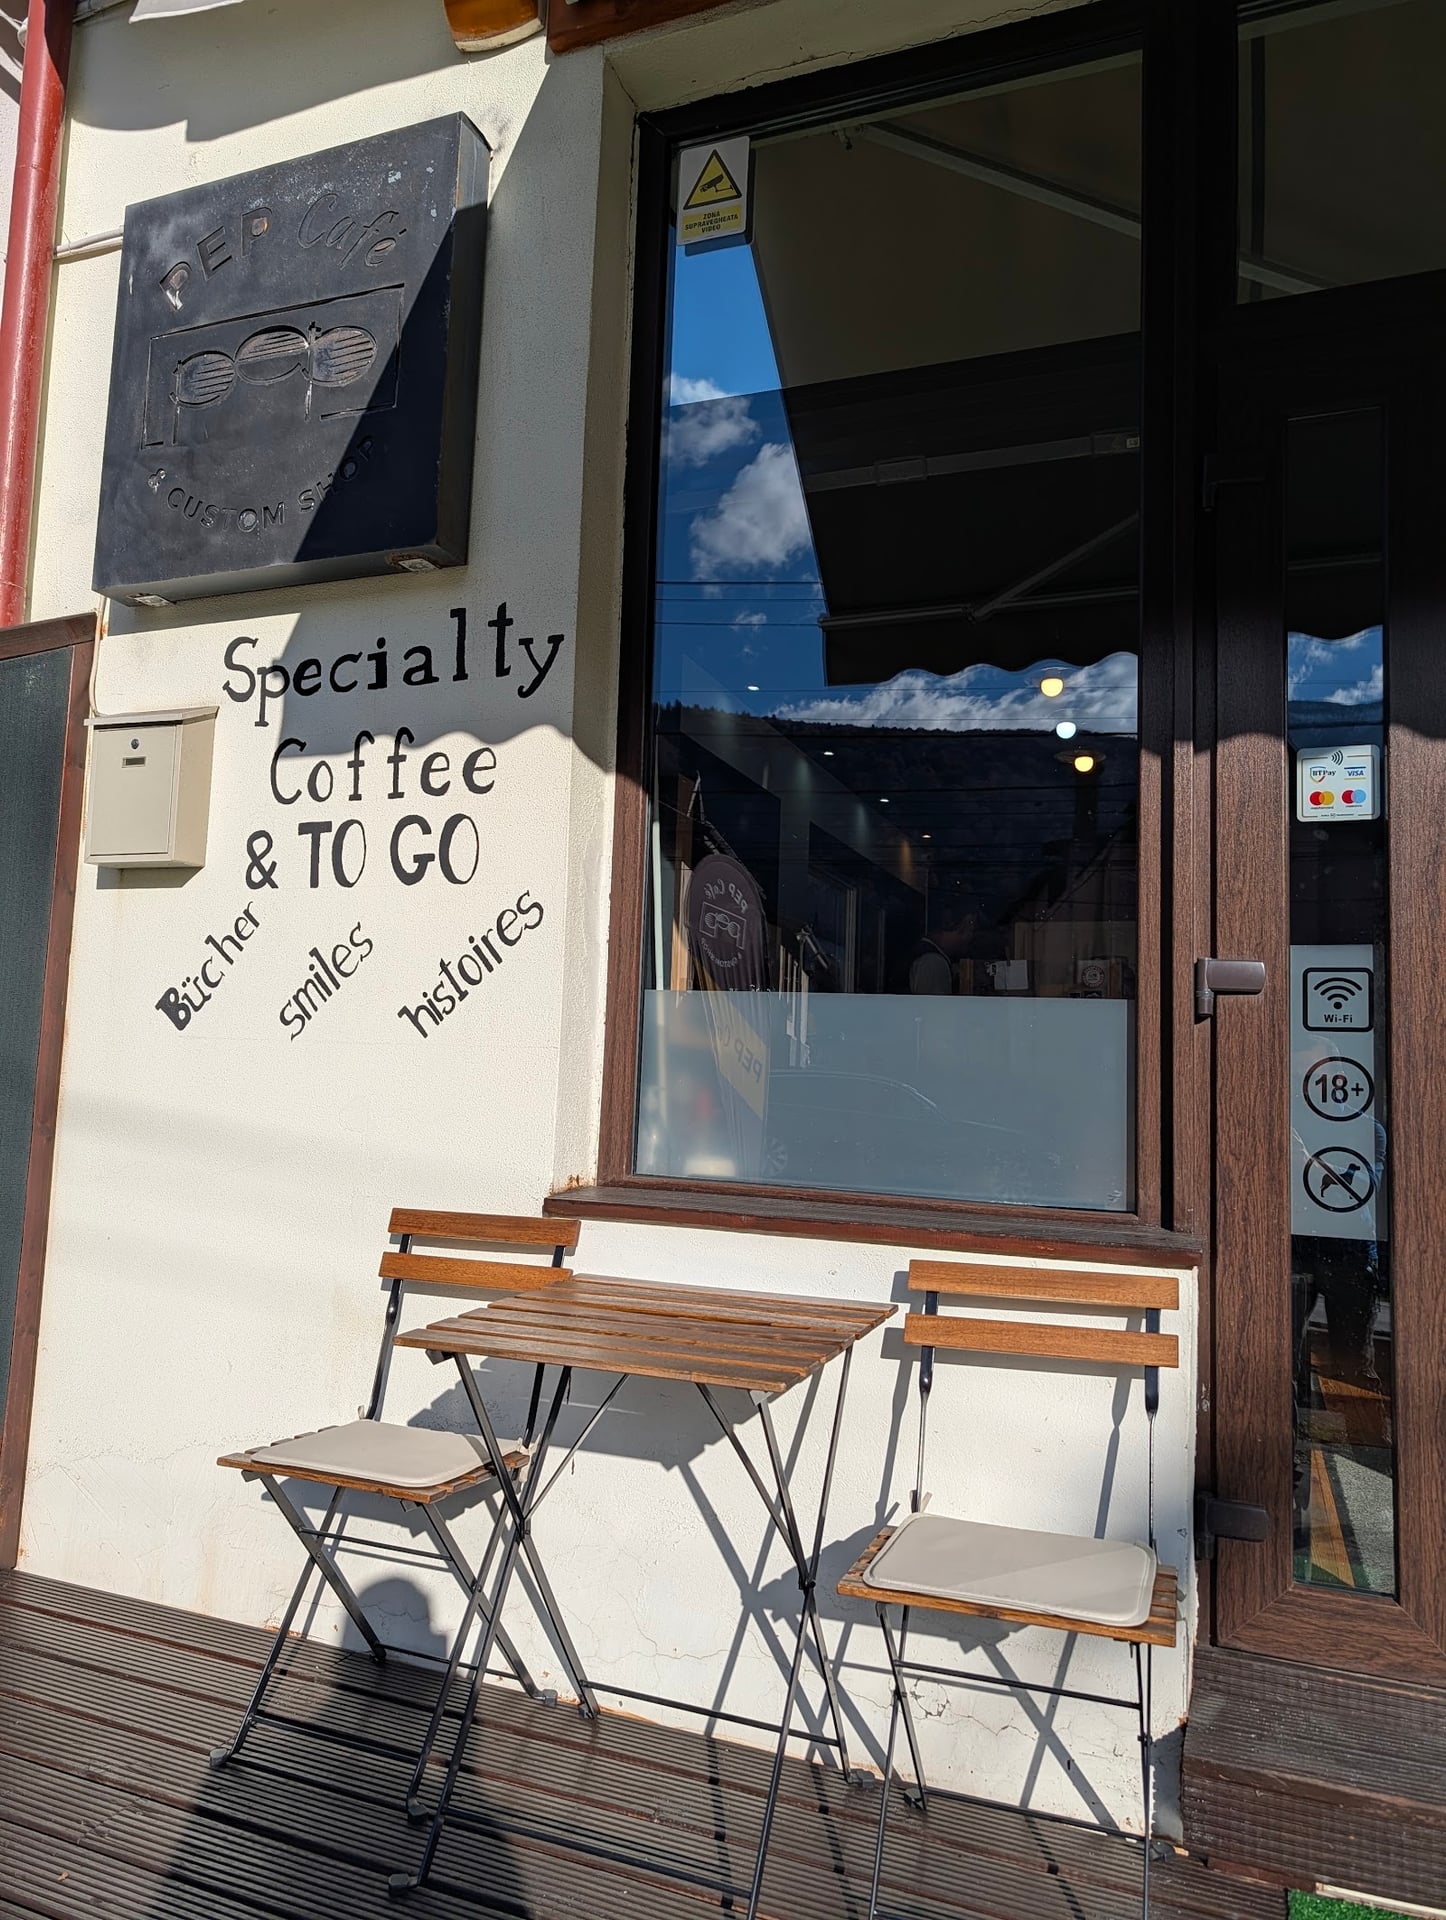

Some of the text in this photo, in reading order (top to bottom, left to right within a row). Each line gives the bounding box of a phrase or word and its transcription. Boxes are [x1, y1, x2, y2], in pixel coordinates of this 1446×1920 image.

[159, 192, 407, 311] PEP Café
[684, 214, 739, 231] SUPRAVEGHEATA
[701, 224, 721, 233] VIDEO
[703, 211, 721, 219] ZONA
[147, 435, 376, 532] & CUSTOM SHOP
[222, 602, 565, 727] Specialty
[270, 727, 498, 805] Coffee
[244, 813, 480, 890] & TO GO
[155, 901, 261, 1031] Bücher
[278, 922, 374, 1041] smiles
[397, 890, 544, 1039] histoires
[1323, 1014, 1353, 1023] Wi-Fi
[1314, 1074, 1364, 1104] 18+
